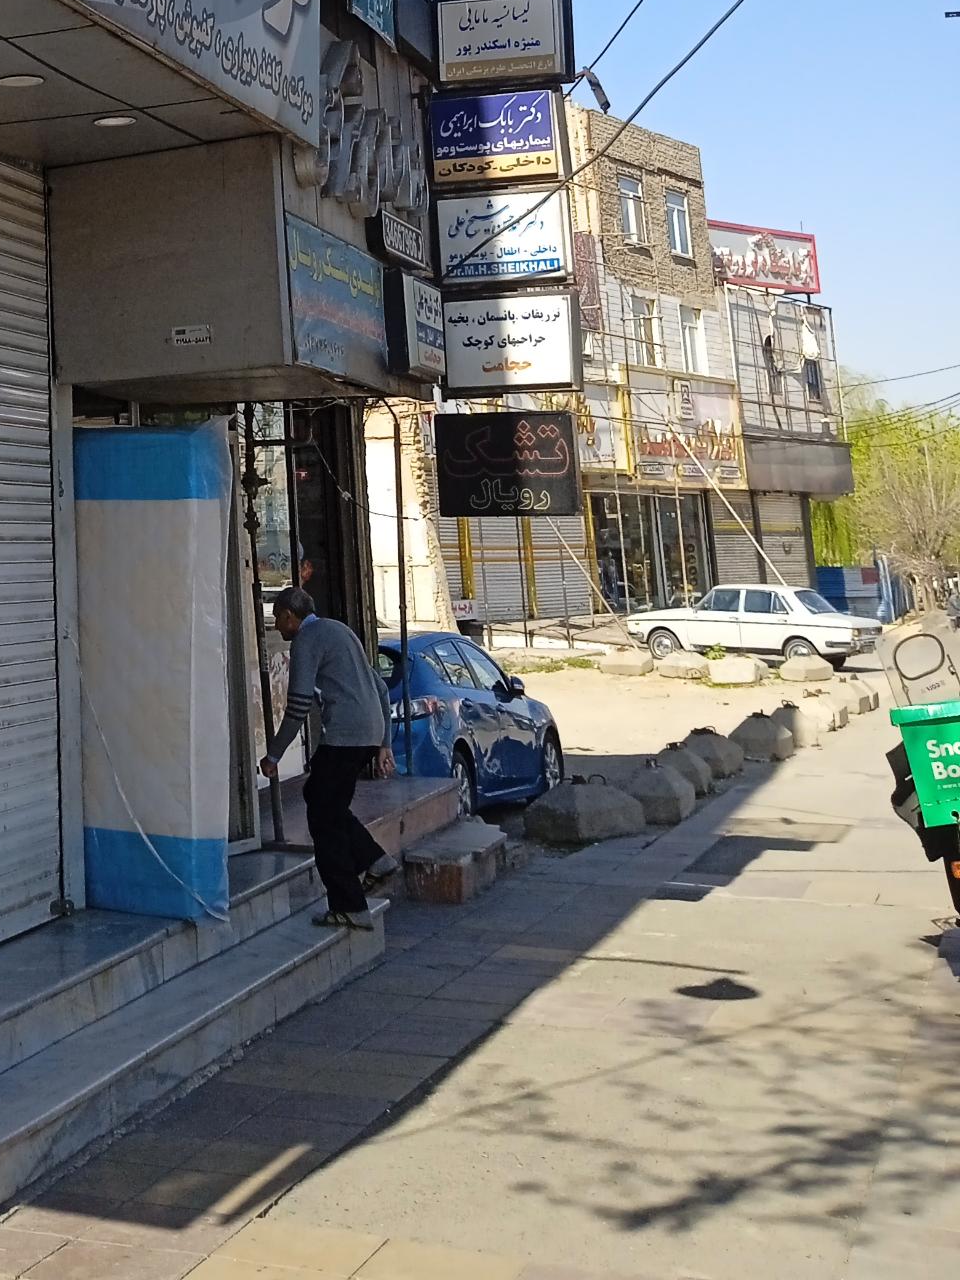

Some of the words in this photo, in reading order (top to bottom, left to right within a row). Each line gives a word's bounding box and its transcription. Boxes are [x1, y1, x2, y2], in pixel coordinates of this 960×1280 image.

[440, 110, 478, 138] ابراهیمی
[478, 95, 518, 133] بابک
[513, 92, 546, 134] دکتر
[491, 134, 551, 152] بیماریهای
[462, 335, 496, 351] کوچک
[481, 356, 533, 374] حجامت
[442, 420, 570, 478] تشک
[470, 478, 551, 510] رویال
